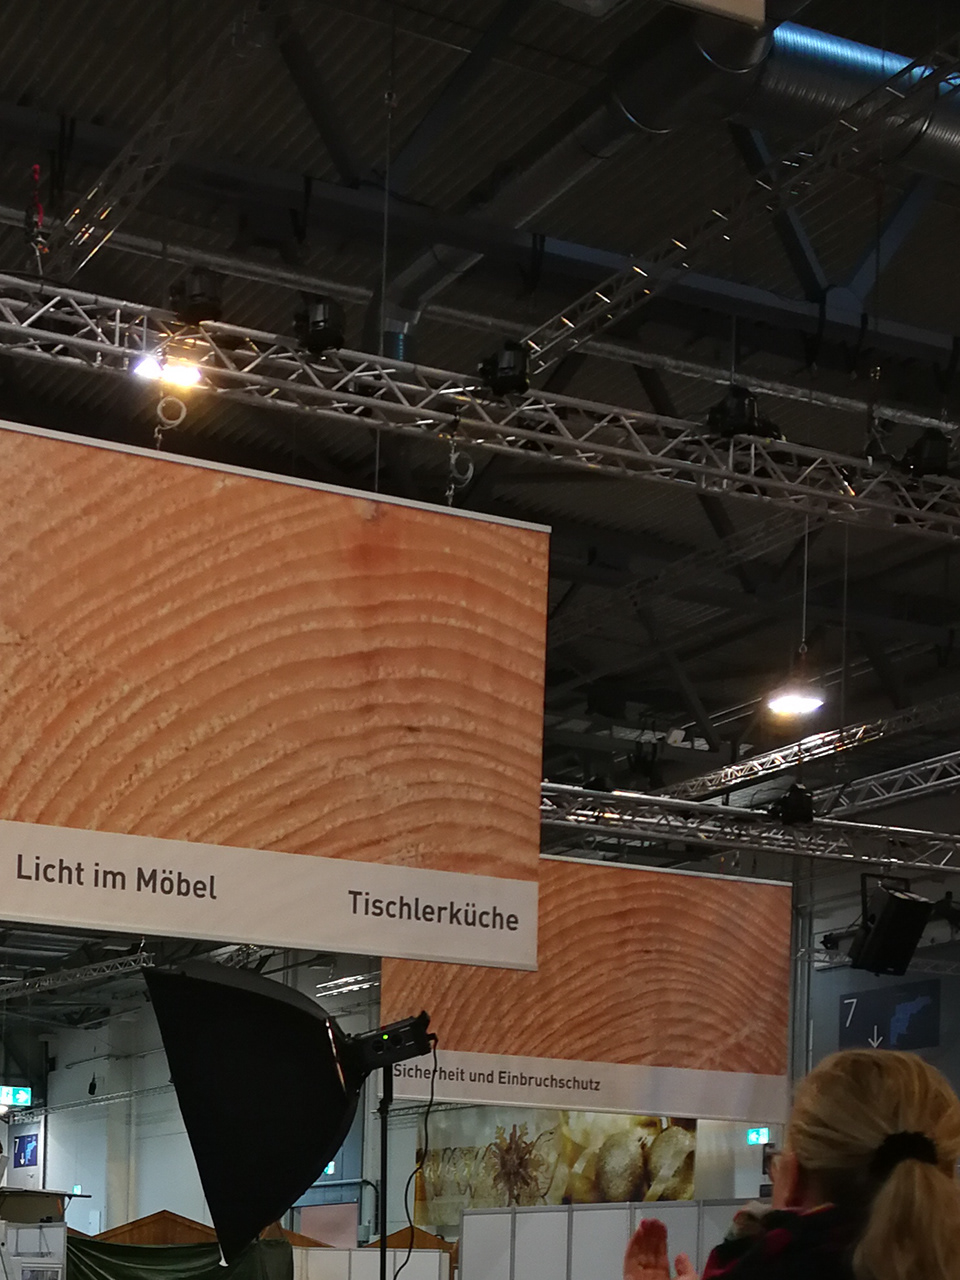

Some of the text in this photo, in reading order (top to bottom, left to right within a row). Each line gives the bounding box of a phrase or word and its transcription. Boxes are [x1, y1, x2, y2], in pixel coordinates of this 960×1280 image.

[16, 853, 217, 900] Licht im Möbel
[347, 889, 519, 931] Tischlerküche
[843, 998, 858, 1028] 7
[393, 1063, 601, 1092] Sicherheit und Einbruchschutz
